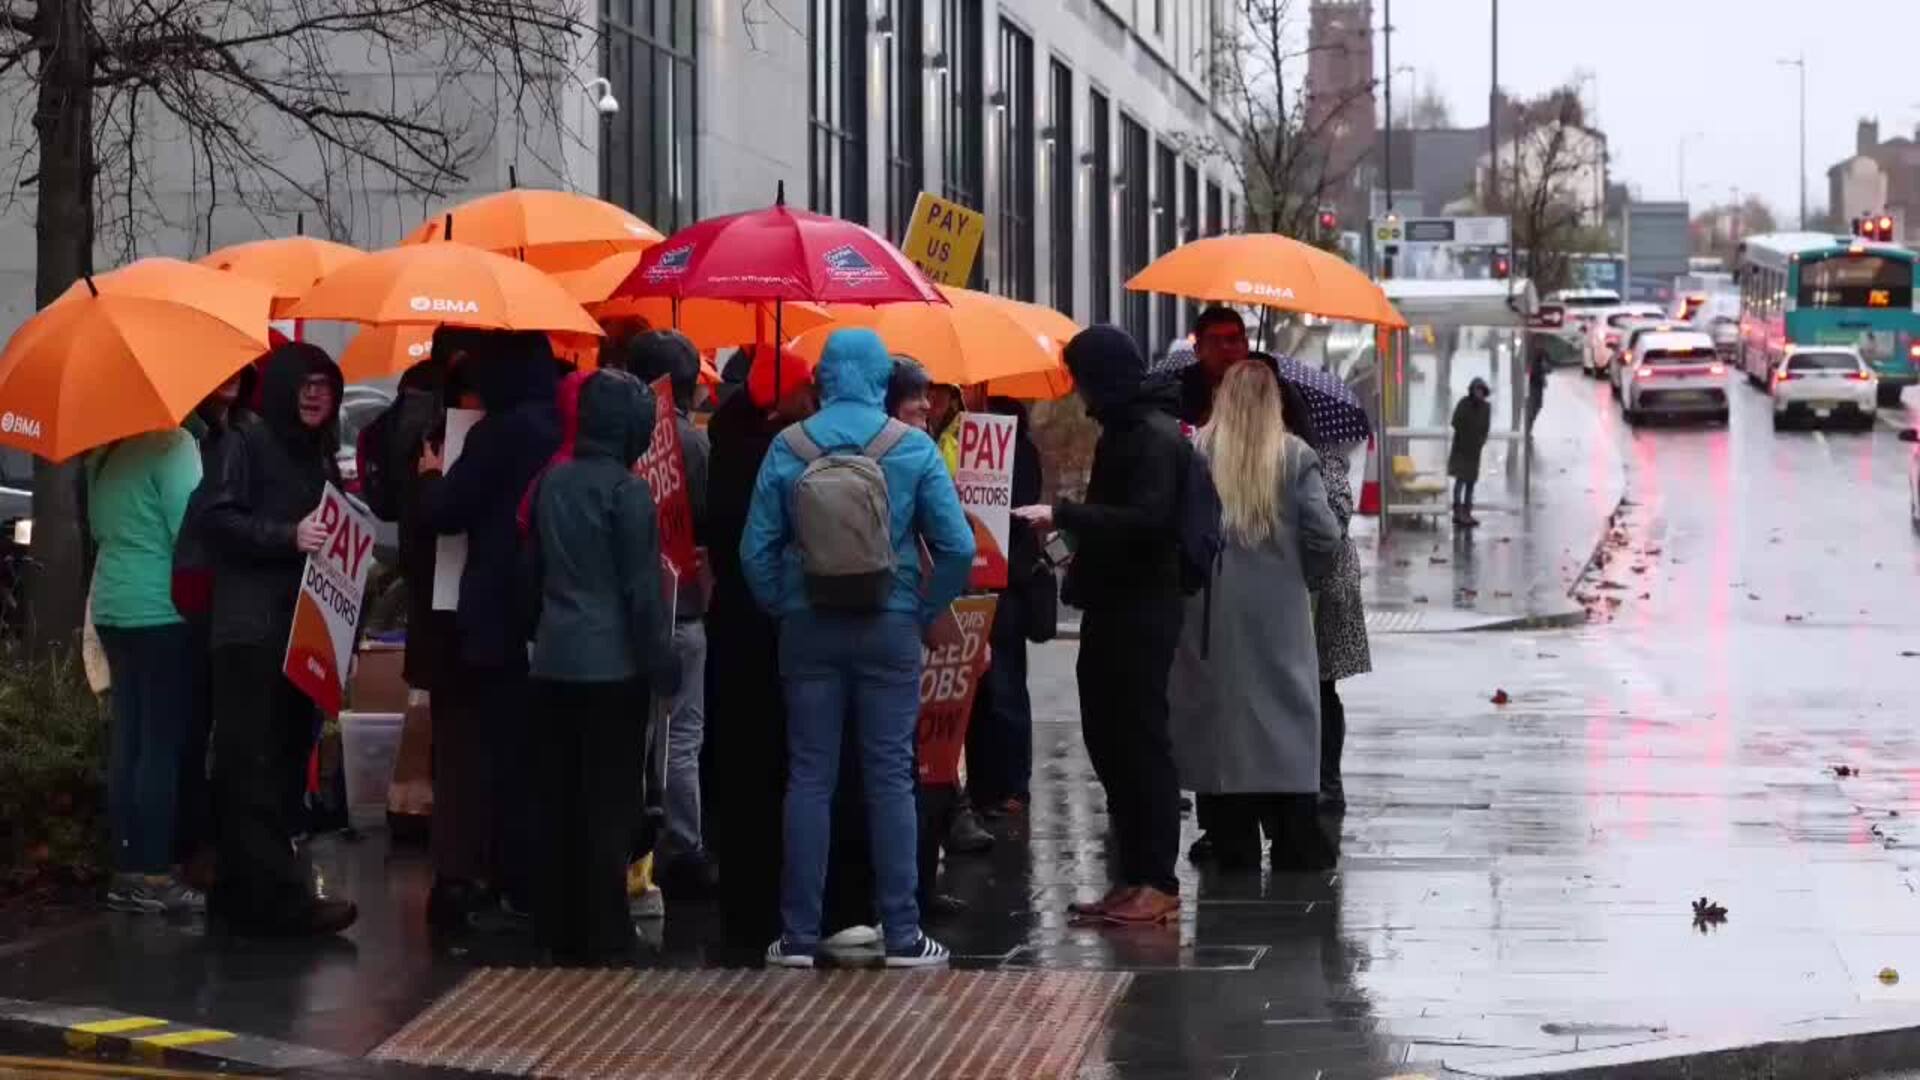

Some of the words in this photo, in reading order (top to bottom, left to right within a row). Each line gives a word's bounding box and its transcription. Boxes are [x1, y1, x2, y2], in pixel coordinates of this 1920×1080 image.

[927, 202, 970, 237] PAY
[927, 236, 951, 262] US
[432, 298, 480, 314] BMA
[14, 414, 41, 440] BMA
[959, 420, 1013, 470] PAY
[321, 494, 372, 581] PAY
[306, 563, 357, 628] DOCTORS
